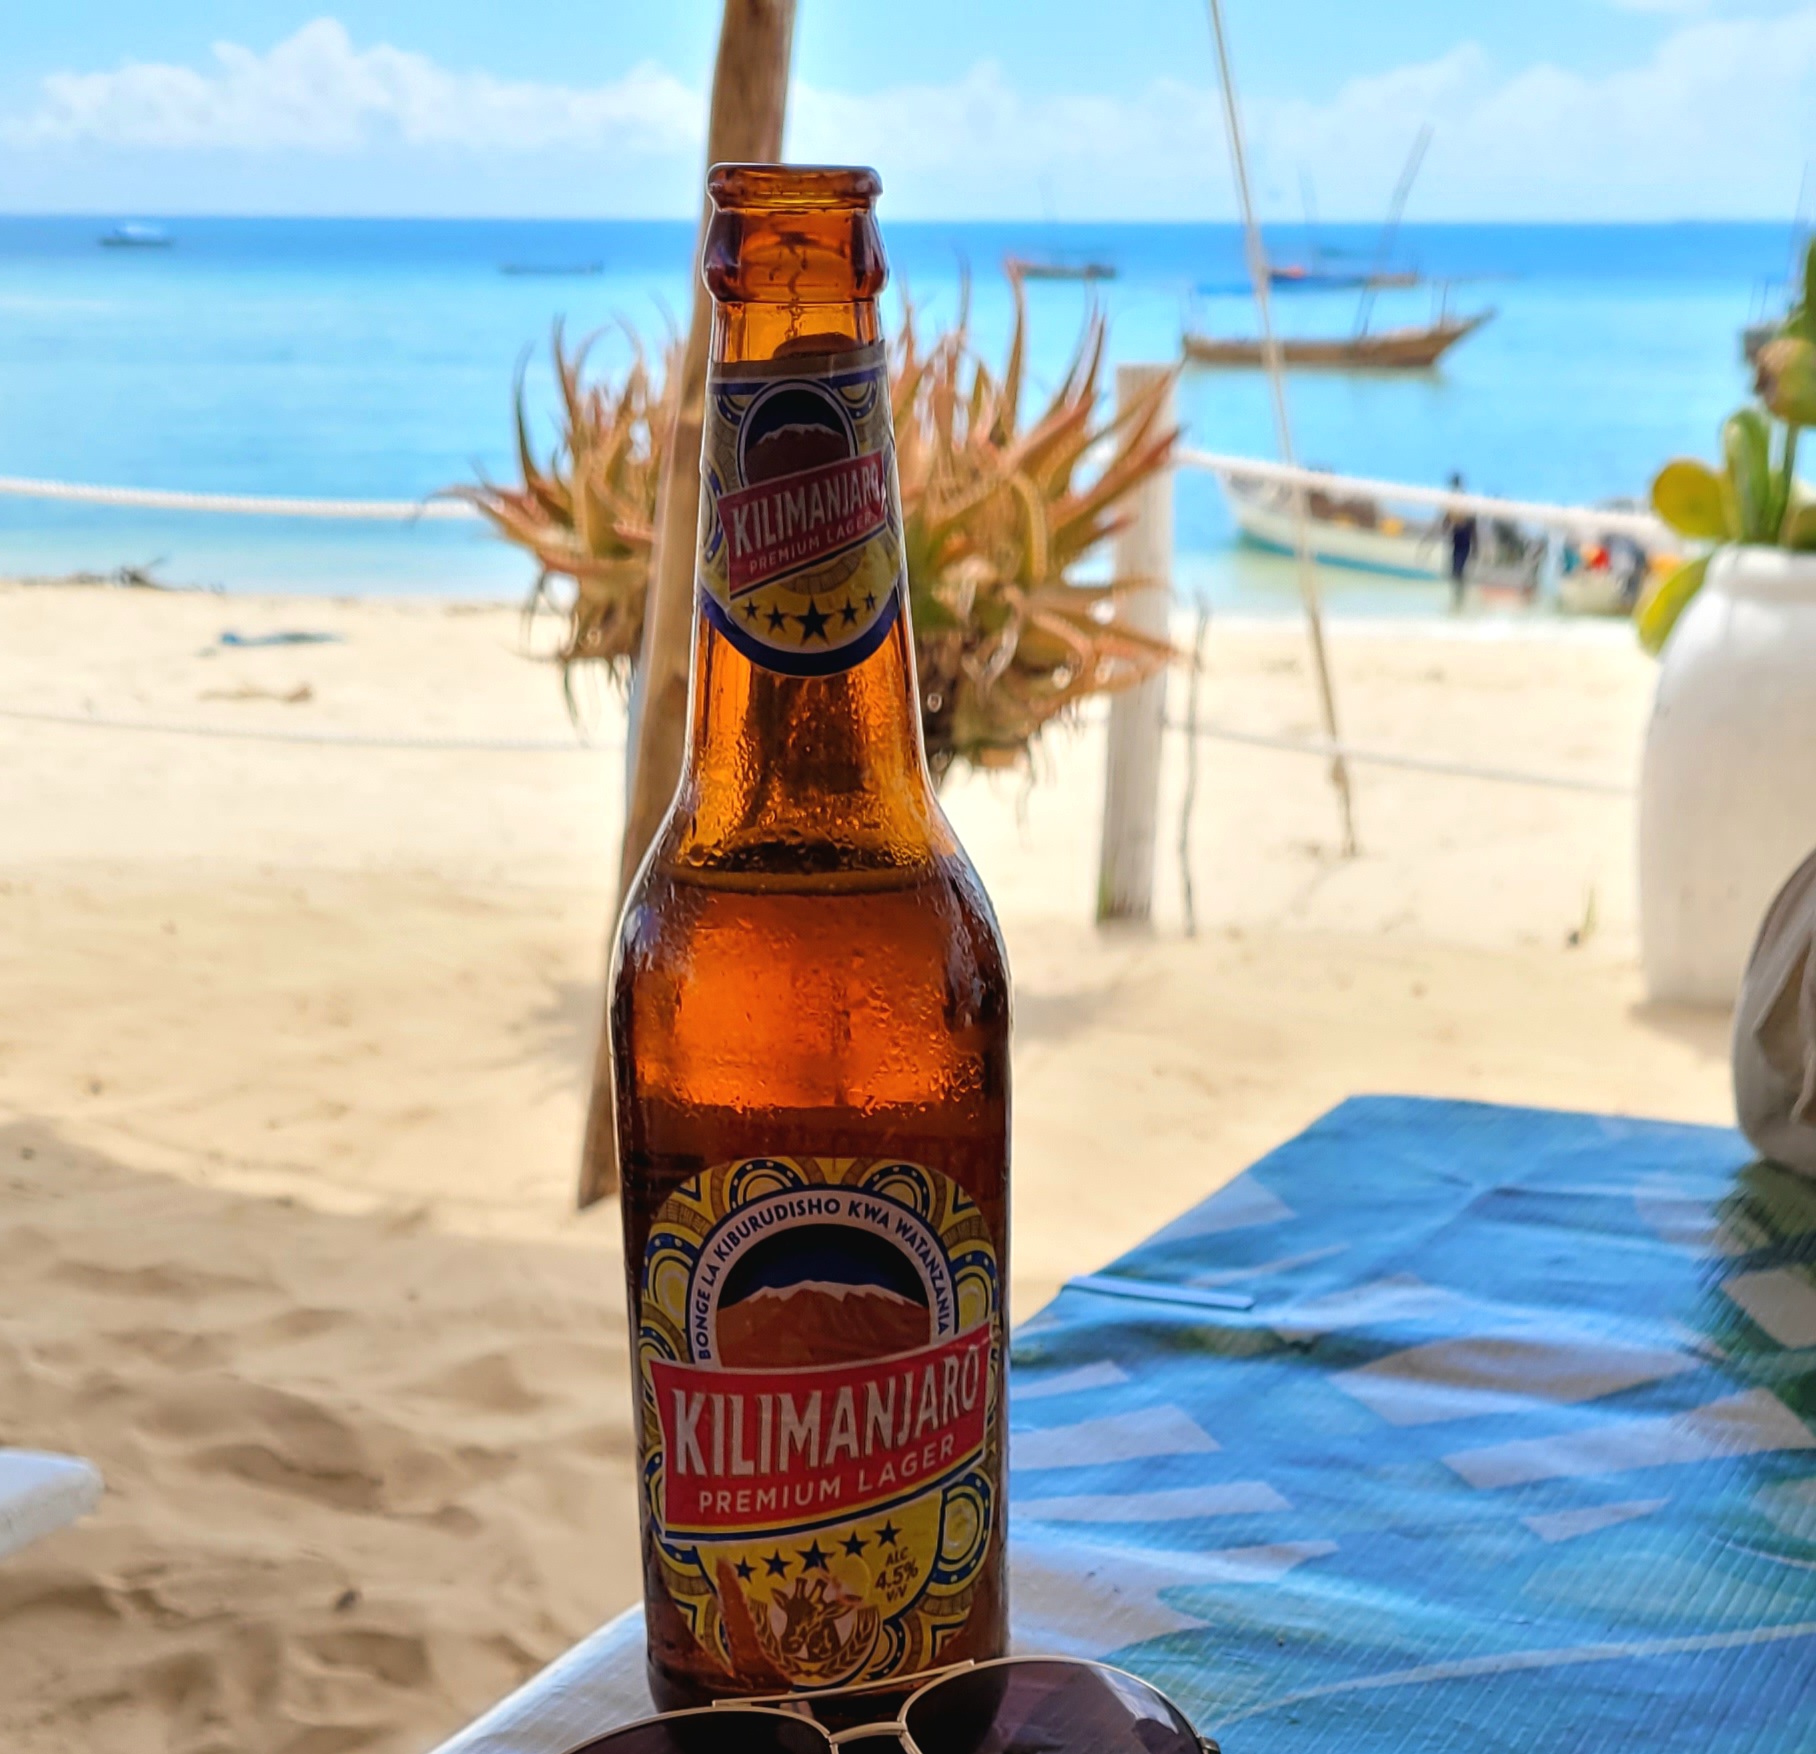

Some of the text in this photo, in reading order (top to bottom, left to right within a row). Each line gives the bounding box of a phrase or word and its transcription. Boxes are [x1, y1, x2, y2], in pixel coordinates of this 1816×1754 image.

[731, 463, 880, 558] KILIMANJARO
[750, 513, 871, 574] PREMIUM LAGER
[695, 1197, 949, 1360] BONGE LA KIBURUDISHO KWA WATANZANIA
[671, 1344, 980, 1477] KILIMANJARO
[700, 1433, 954, 1514] PREMIUM LAGER
[874, 1561, 919, 1590] 4.5%
[886, 1545, 909, 1563] ALC
